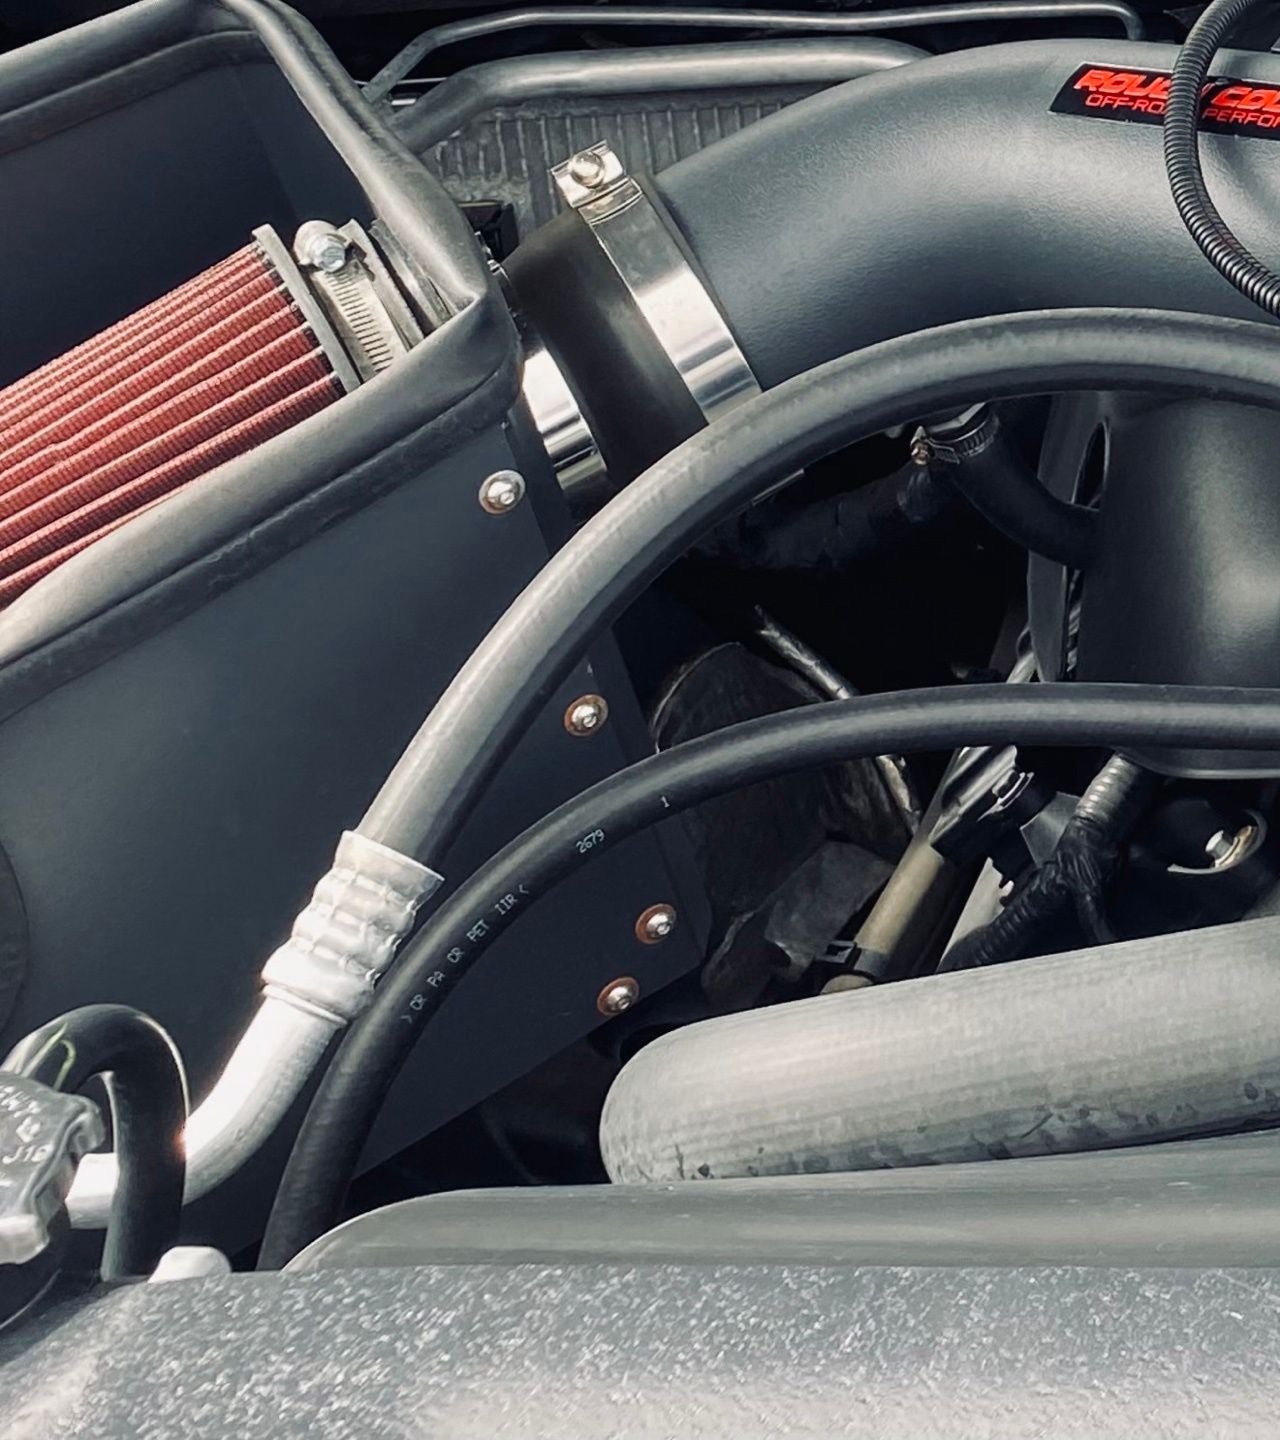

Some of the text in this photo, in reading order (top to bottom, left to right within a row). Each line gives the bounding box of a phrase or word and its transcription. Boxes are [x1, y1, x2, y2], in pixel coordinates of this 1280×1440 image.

[1074, 69, 1207, 106] ROUG
[1085, 93, 1168, 114] OFF-ROA
[575, 829, 606, 854] 2679
[427, 970, 446, 988] PA
[466, 918, 490, 943] PET
[494, 893, 518, 916] IIR
